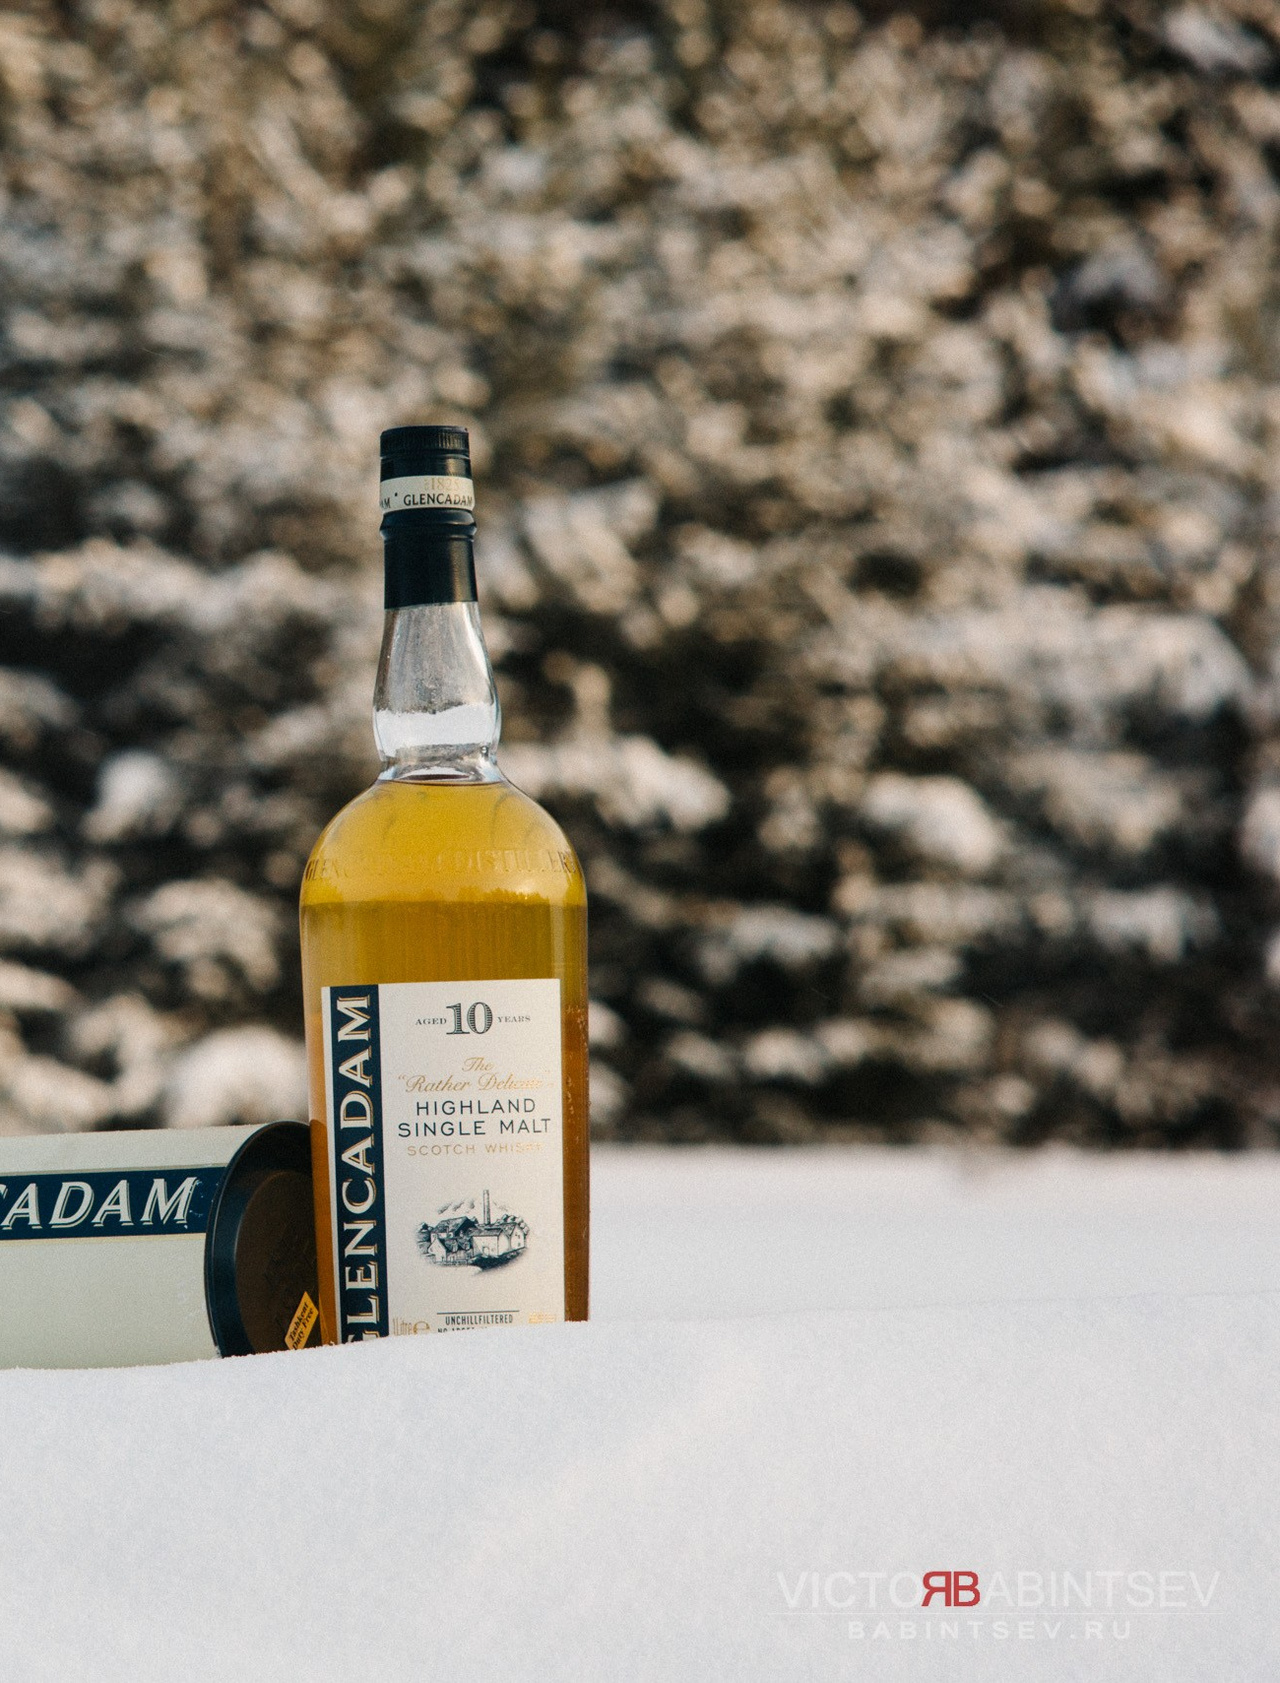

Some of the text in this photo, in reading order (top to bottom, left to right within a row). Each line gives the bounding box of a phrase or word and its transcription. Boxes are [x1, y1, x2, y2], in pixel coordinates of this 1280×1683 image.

[403, 493, 473, 507] GLENCADAM
[415, 1001, 531, 1035] AGED 10 YEARS
[461, 1057, 494, 1073] The
[416, 1098, 536, 1116] HIGHLAND
[398, 1118, 551, 1137] SINGLE MALT
[407, 1144, 476, 1156] SCOTCH
[337, 995, 380, 1342] LENCADAM
[289, 1301, 309, 1341] Tashkent
[302, 1307, 314, 1329] Free
[445, 1314, 513, 1325] UNCHILLFILTERED
